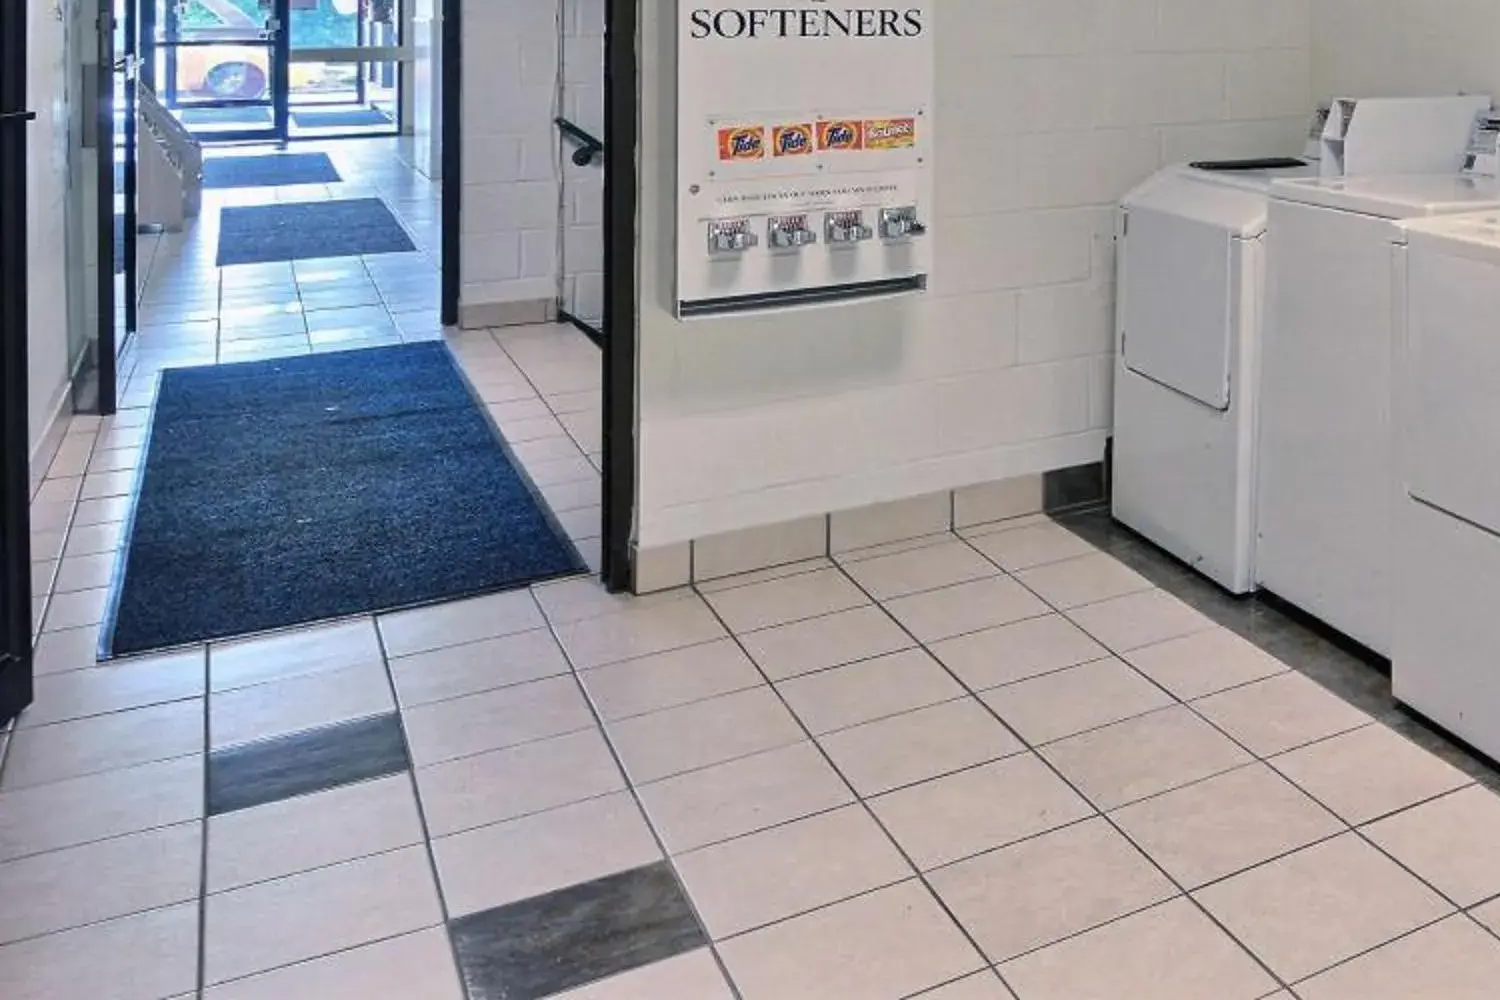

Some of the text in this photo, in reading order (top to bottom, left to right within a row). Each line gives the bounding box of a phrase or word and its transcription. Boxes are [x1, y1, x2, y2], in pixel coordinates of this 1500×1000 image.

[690, 8, 923, 39] SOFTENERS
[732, 135, 761, 156] Tide
[781, 134, 808, 153] Tide
[827, 127, 853, 147] Tide
